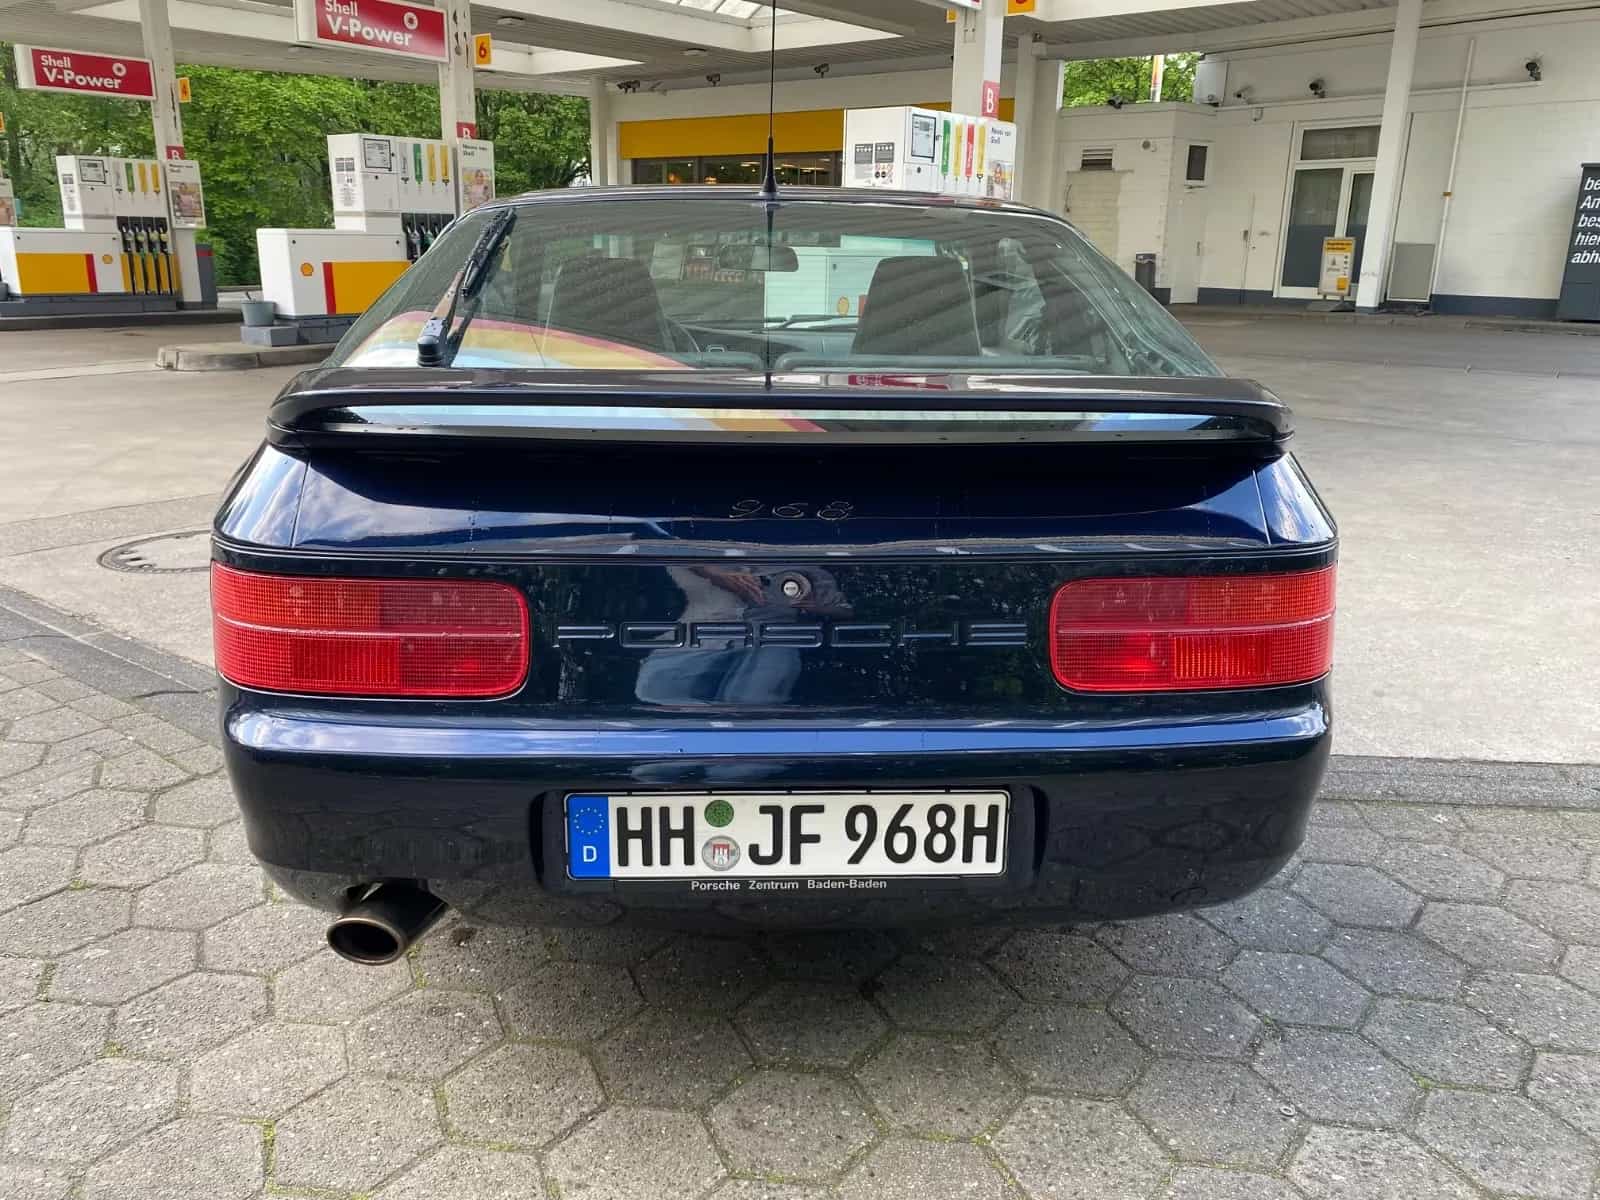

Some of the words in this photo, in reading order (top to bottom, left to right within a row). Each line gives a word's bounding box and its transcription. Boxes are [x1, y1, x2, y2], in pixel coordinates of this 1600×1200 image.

[325, 0, 358, 17] Shell
[325, 14, 413, 46] V-Power
[478, 42, 487, 58] 6
[40, 55, 71, 68] Shell
[43, 68, 122, 89] V-Power
[986, 87, 994, 113] B
[729, 499, 854, 520] 968
[553, 622, 1028, 650] PORSCHE
[616, 805, 695, 867] HH
[748, 804, 825, 866] JF
[844, 803, 1000, 865] 968H
[583, 845, 597, 862] D
[691, 880, 741, 891] Porsche
[749, 880, 799, 890] Zentrum
[807, 879, 887, 889] Baden-Baden
